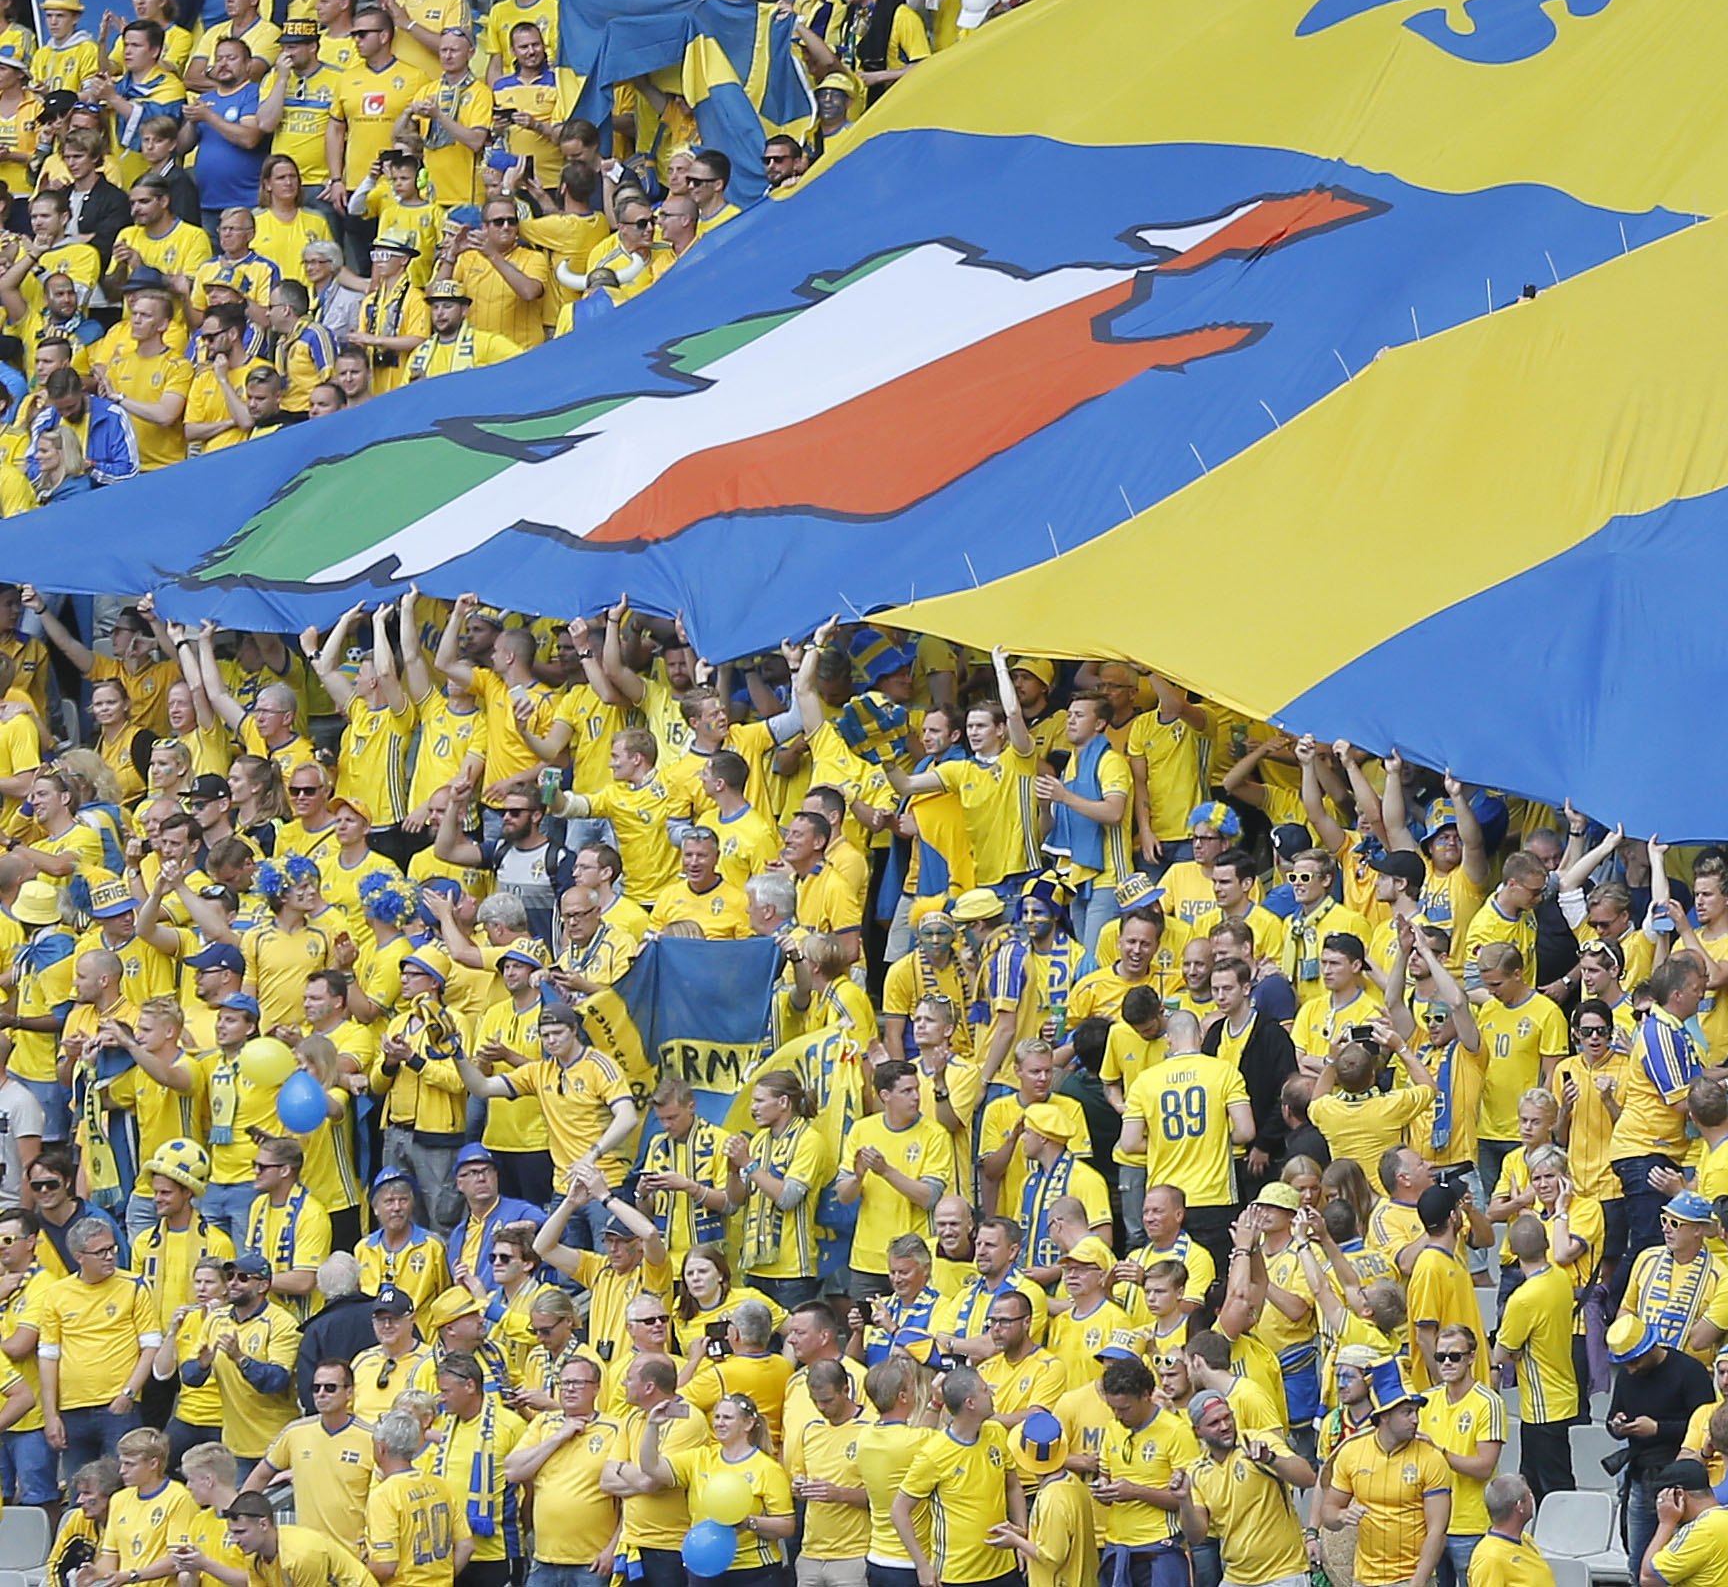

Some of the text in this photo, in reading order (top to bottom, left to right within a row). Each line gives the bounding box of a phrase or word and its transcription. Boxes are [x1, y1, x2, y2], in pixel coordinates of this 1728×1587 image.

[664, 722, 684, 745] 15
[1494, 1033, 1511, 1058] 10
[1160, 1085, 1207, 1141] 89
[412, 1502, 453, 1565] 20
